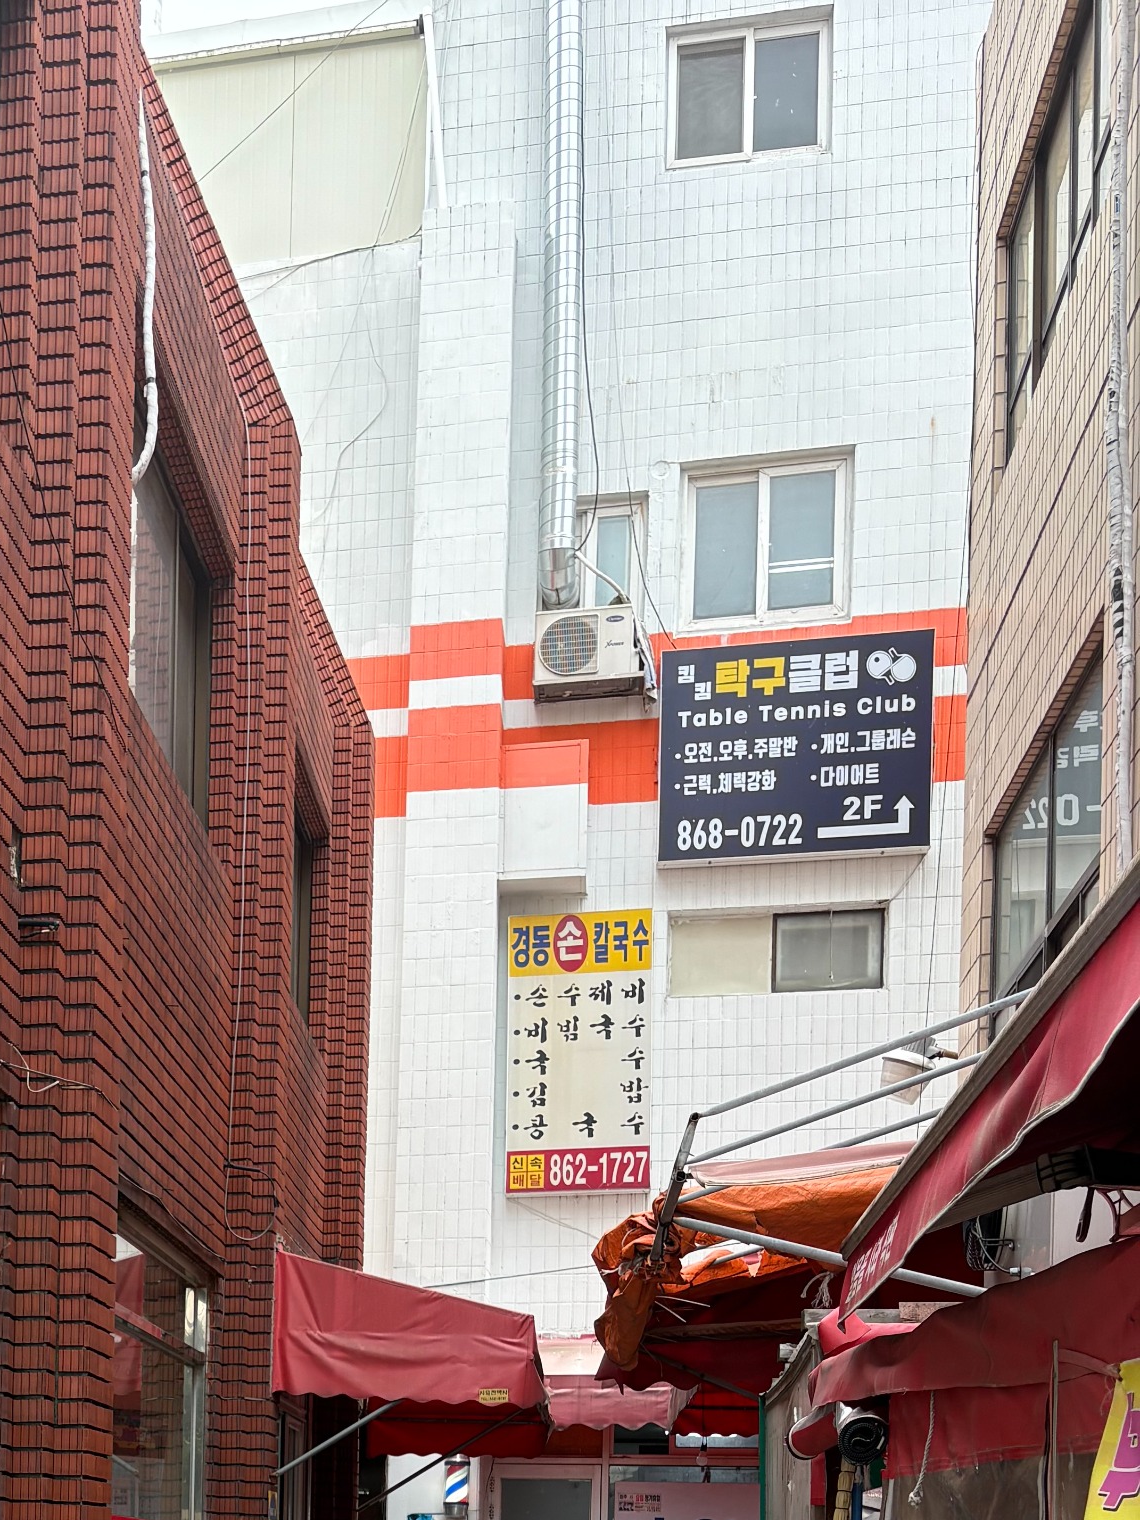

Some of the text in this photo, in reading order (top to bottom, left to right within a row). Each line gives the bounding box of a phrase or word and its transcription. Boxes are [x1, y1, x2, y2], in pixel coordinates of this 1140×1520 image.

[715, 650, 859, 698] 탁구클럽
[678, 693, 916, 727] Table Tennis Club
[820, 763, 880, 787] 다이어트
[843, 794, 883, 820] 2F
[677, 813, 803, 850] 868-0722
[549, 1151, 648, 1186] 862-1727
